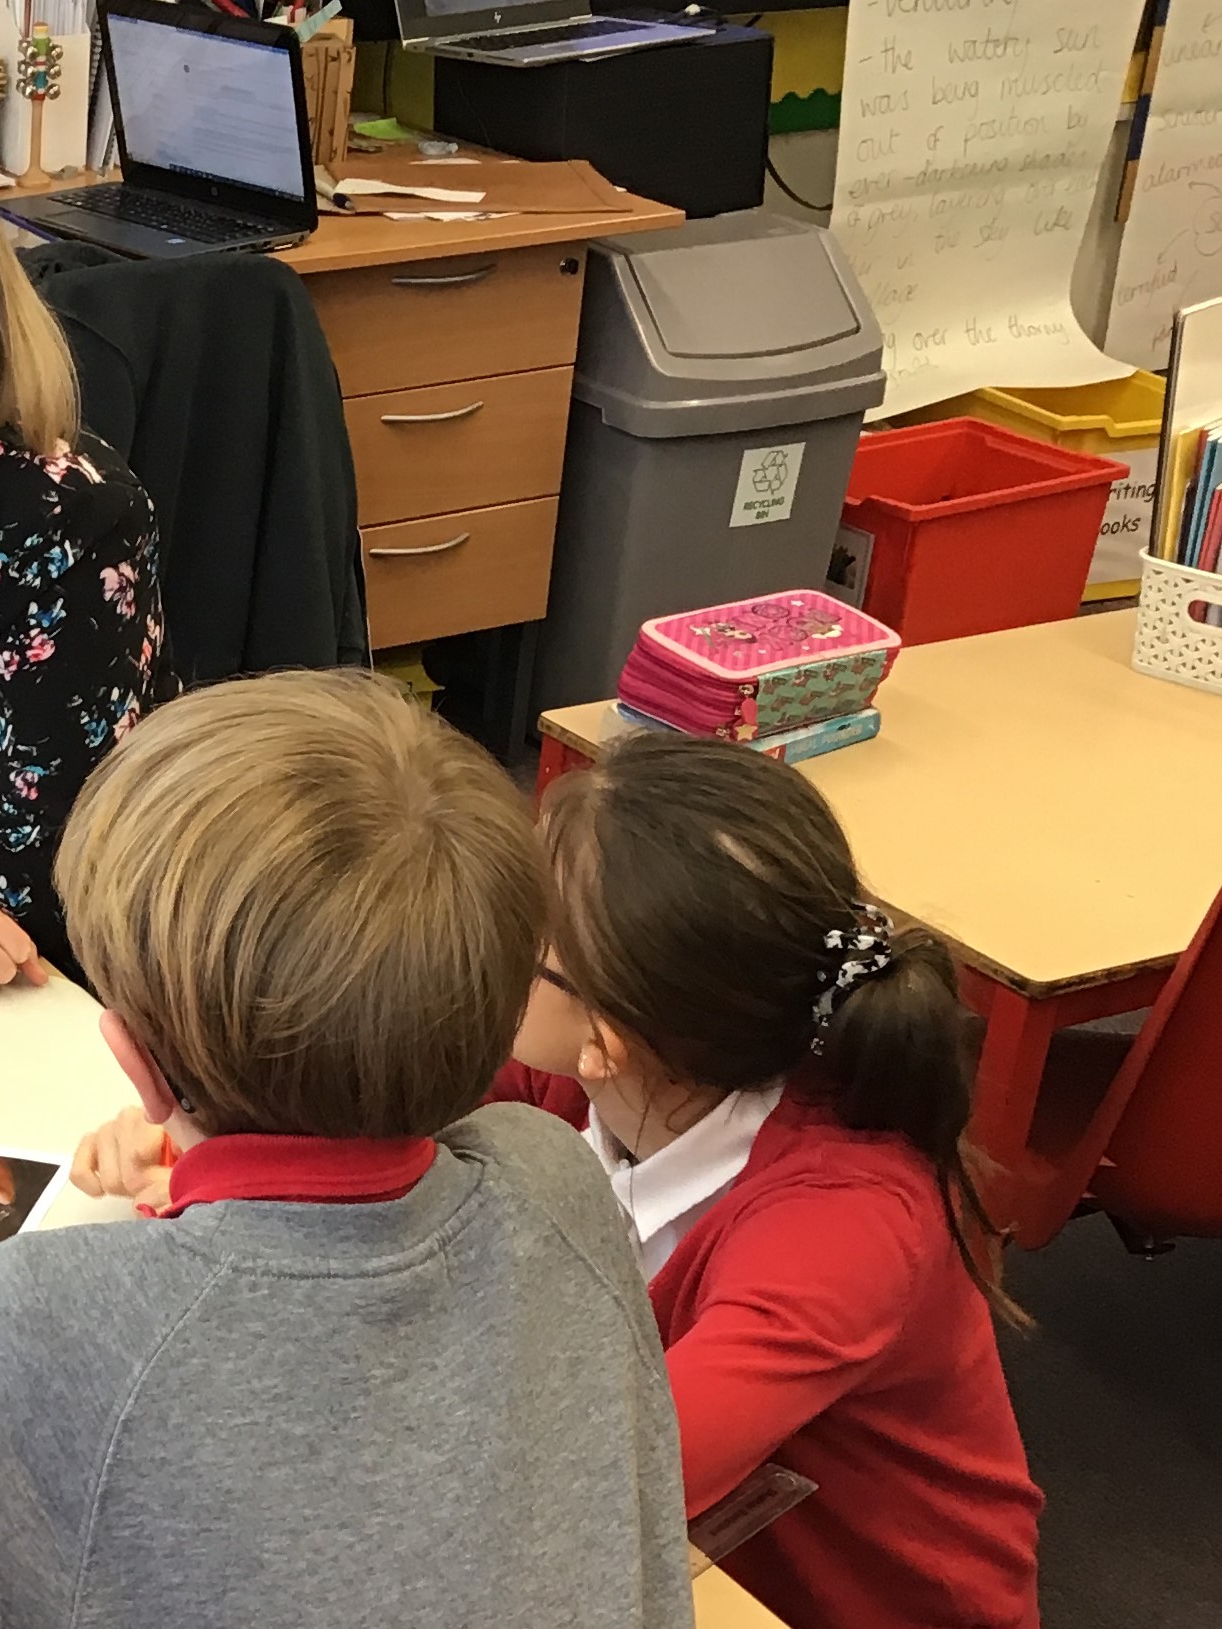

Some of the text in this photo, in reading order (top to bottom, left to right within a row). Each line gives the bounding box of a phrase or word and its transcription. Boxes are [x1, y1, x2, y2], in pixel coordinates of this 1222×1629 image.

[881, 35, 914, 73] the
[860, 90, 909, 117] was
[931, 75, 980, 120] being
[856, 128, 900, 162] out
[963, 106, 1047, 157] position
[912, 331, 949, 352] over
[965, 314, 998, 346] the
[743, 496, 785, 510] RECYCLING
[755, 509, 770, 520] BIN
[1099, 514, 1141, 535] ooks
